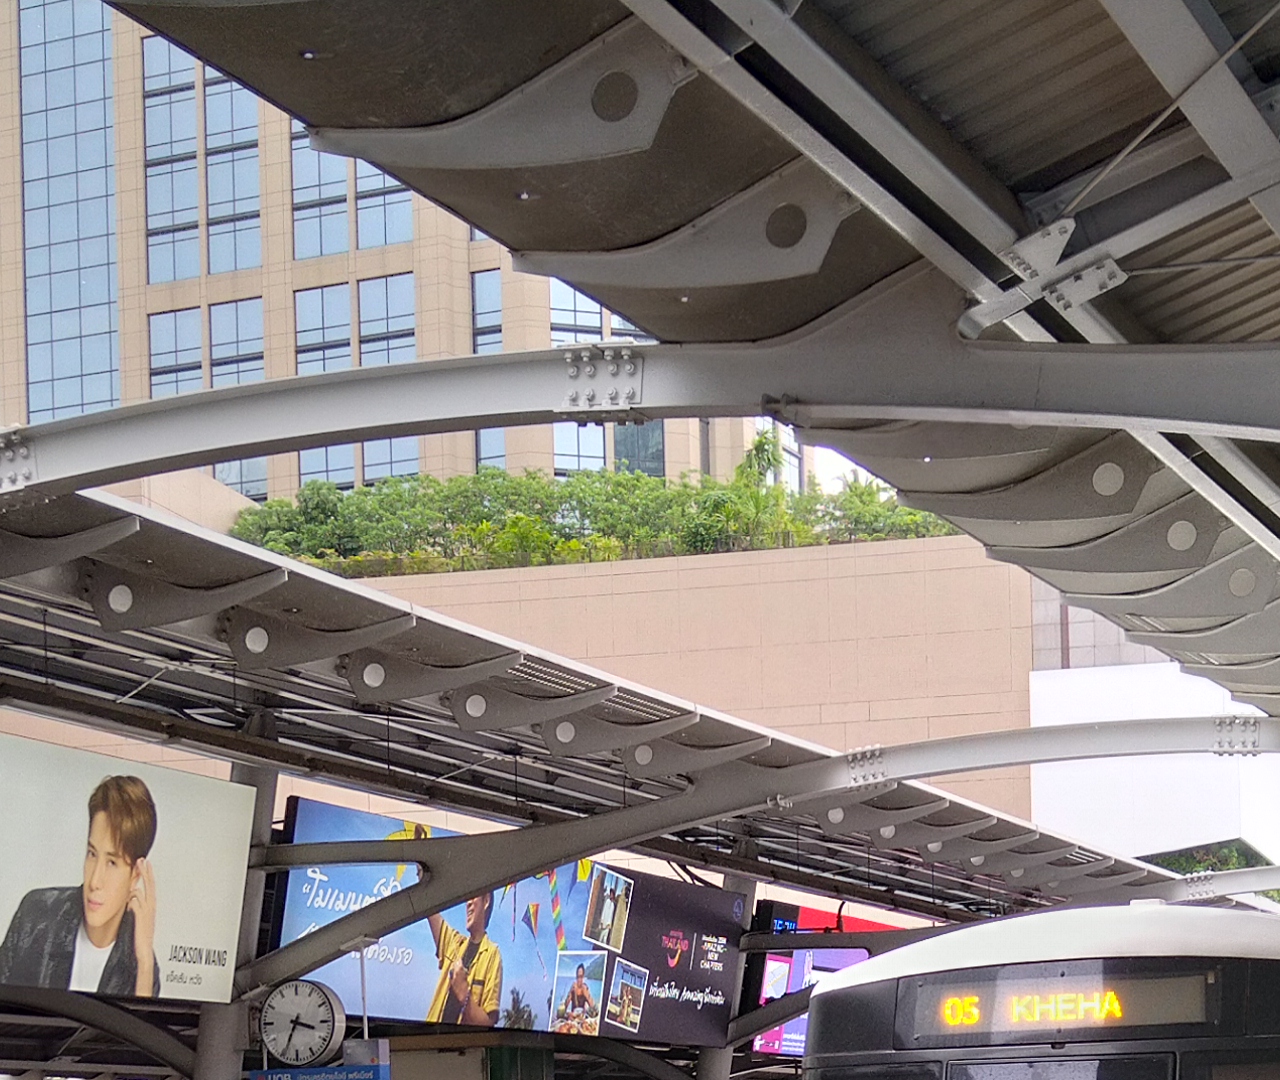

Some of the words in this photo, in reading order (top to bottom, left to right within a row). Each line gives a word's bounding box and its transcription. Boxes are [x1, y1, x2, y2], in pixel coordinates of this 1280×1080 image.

[169, 945, 204, 965] JACKSON
[204, 949, 228, 967] WANG
[943, 995, 980, 1026] 05
[1012, 991, 1122, 1022] KHEHA
